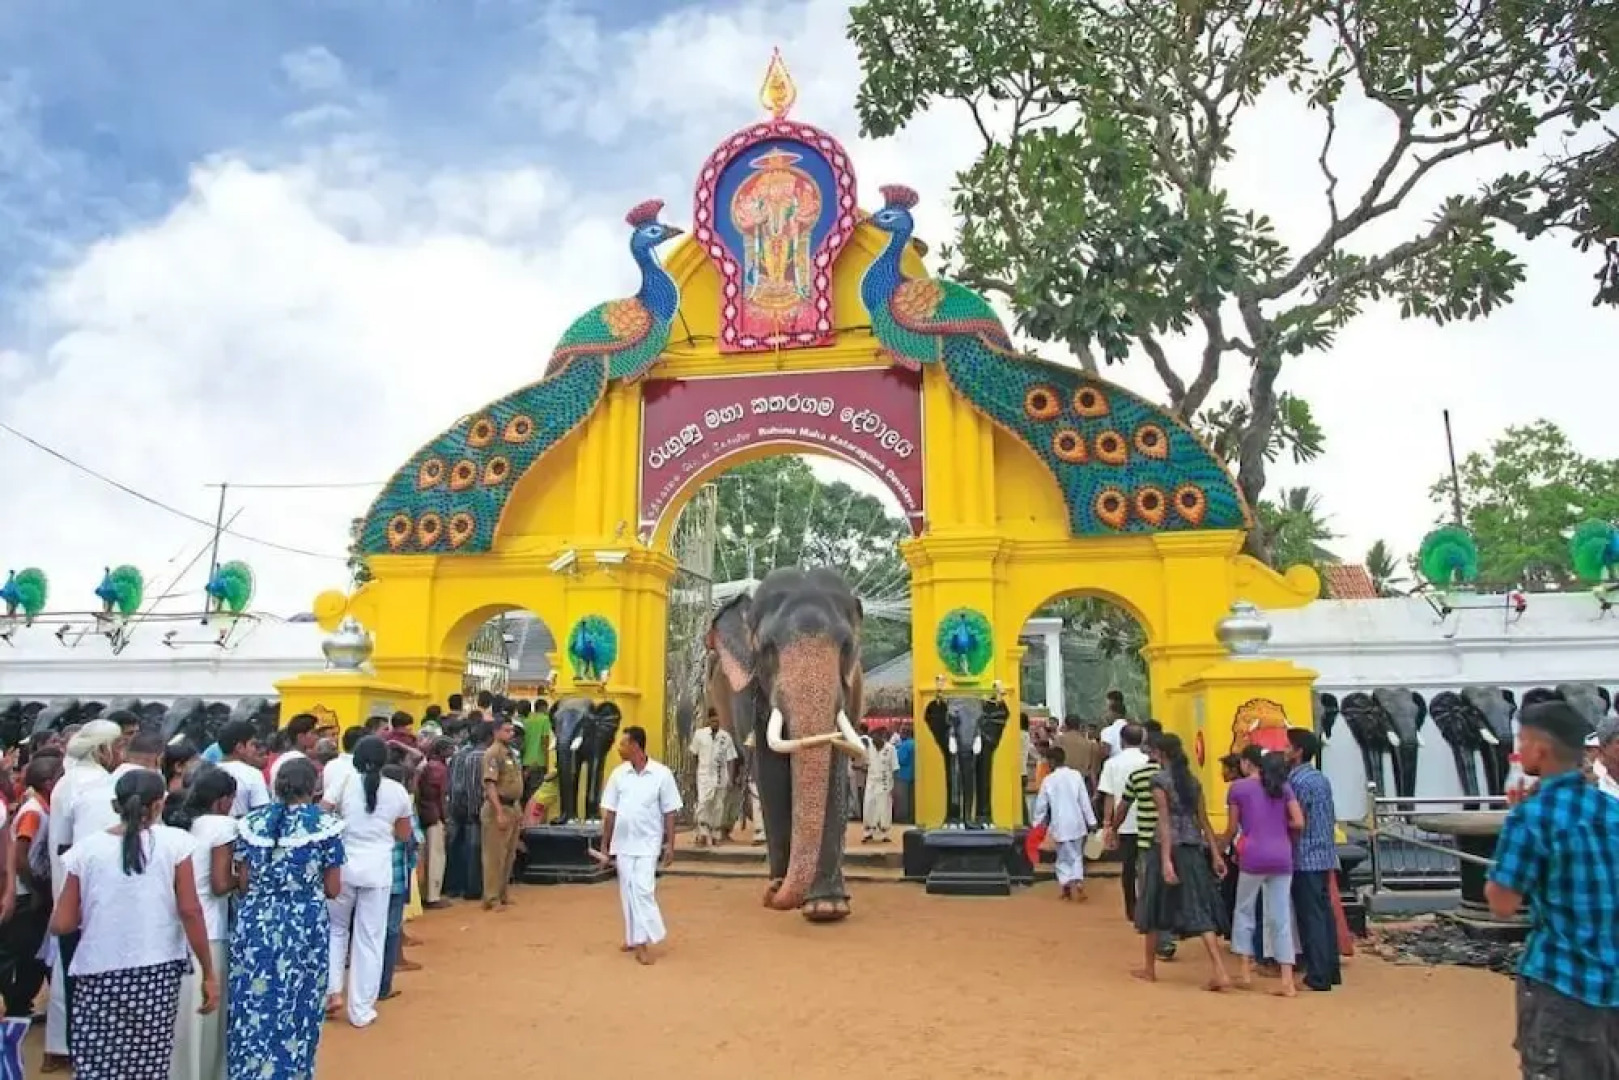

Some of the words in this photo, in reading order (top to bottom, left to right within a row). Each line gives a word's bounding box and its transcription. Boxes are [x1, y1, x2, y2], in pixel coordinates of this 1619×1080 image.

[648, 424, 703, 468] රුහුණු
[704, 402, 744, 428] මහා
[751, 394, 834, 416] කතරගම
[840, 407, 913, 457] දේවාලය
